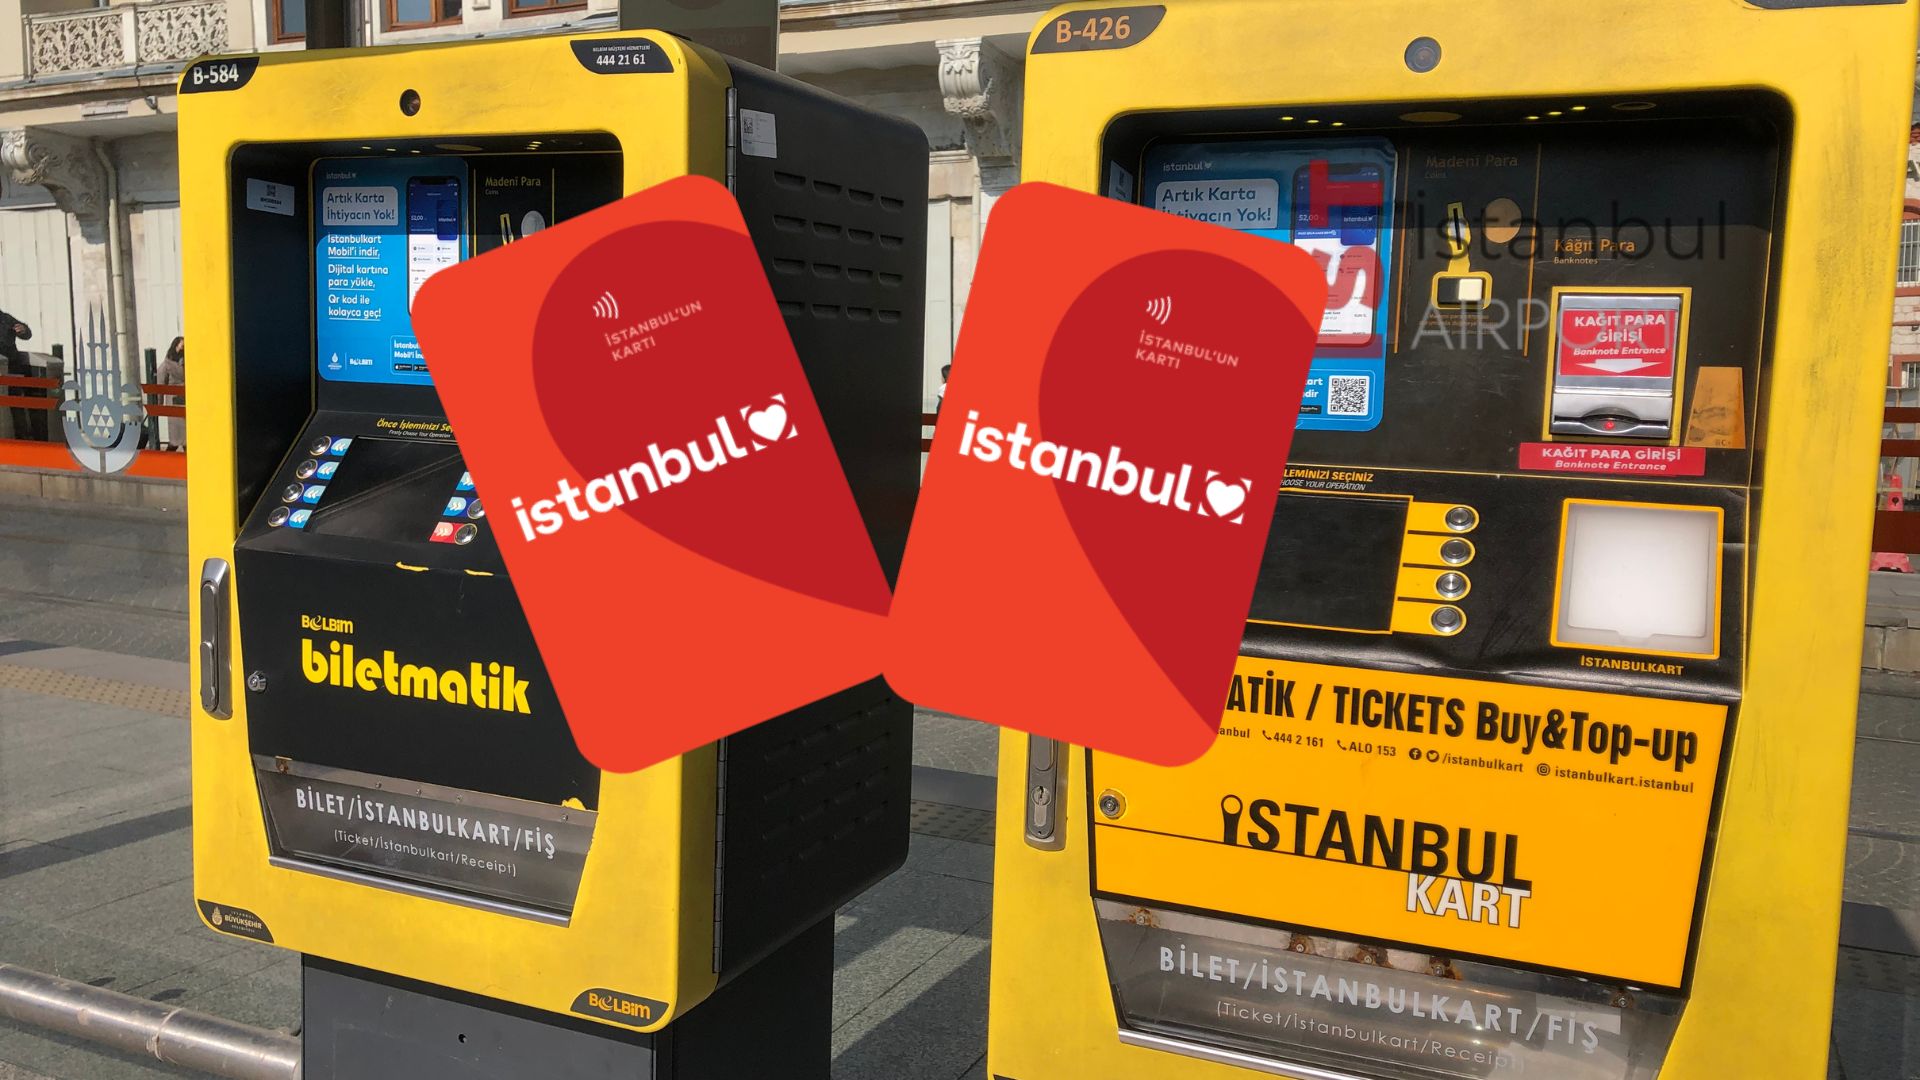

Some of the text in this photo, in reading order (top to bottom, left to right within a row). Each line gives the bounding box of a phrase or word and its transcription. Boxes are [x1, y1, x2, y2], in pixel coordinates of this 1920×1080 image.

[1056, 14, 1131, 43] B-426
[596, 53, 646, 66] 444 21 61
[193, 63, 239, 85] B-584
[1163, 162, 1203, 172] istanbul
[484, 176, 541, 187] Madeni Para
[327, 192, 384, 204] Artık Karta
[1162, 187, 1256, 202] Artık Karta
[327, 206, 395, 222] İhtiyacın Yok!
[1237, 207, 1272, 222] Yok!
[327, 232, 382, 244] İstanbulkart
[1600, 239, 1635, 252] Para
[328, 264, 389, 276] Dijital kartına
[328, 280, 349, 288] para
[328, 294, 370, 305] Qr kod ile
[328, 307, 361, 320] kolayca
[1575, 312, 1666, 327] KAĞIT PARA
[1596, 328, 1643, 344] GİRİŞİ
[1573, 347, 1620, 356] Banknote
[377, 418, 398, 428] Önce
[1542, 447, 1681, 461] KAĞIT PARA GİRİŞİ
[1555, 460, 1667, 471] Banknote Entrance
[1284, 469, 1374, 482] LEMİNİZİ SEÇİNİZ
[1326, 483, 1366, 491] OPERATION
[1581, 654, 1684, 675] İSTANBULKART
[301, 638, 532, 715] biletmatik
[1226, 670, 1698, 773] ATİK / TICKETS Buy&Top-up
[1273, 732, 1293, 744] 444
[1296, 735, 1302, 745] 2
[1306, 736, 1324, 748] 161
[1349, 741, 1373, 754] ALO
[1377, 745, 1396, 757] 153
[1442, 753, 1524, 774] /istanbulkart
[1555, 765, 1695, 794] istanbulkart.istanbul
[296, 786, 555, 859] BİLET/İSTANBULKART/FİŞ
[1406, 872, 1532, 929] KART
[1160, 944, 1600, 1054] BİLET/İSTANBULKART/FİŞ
